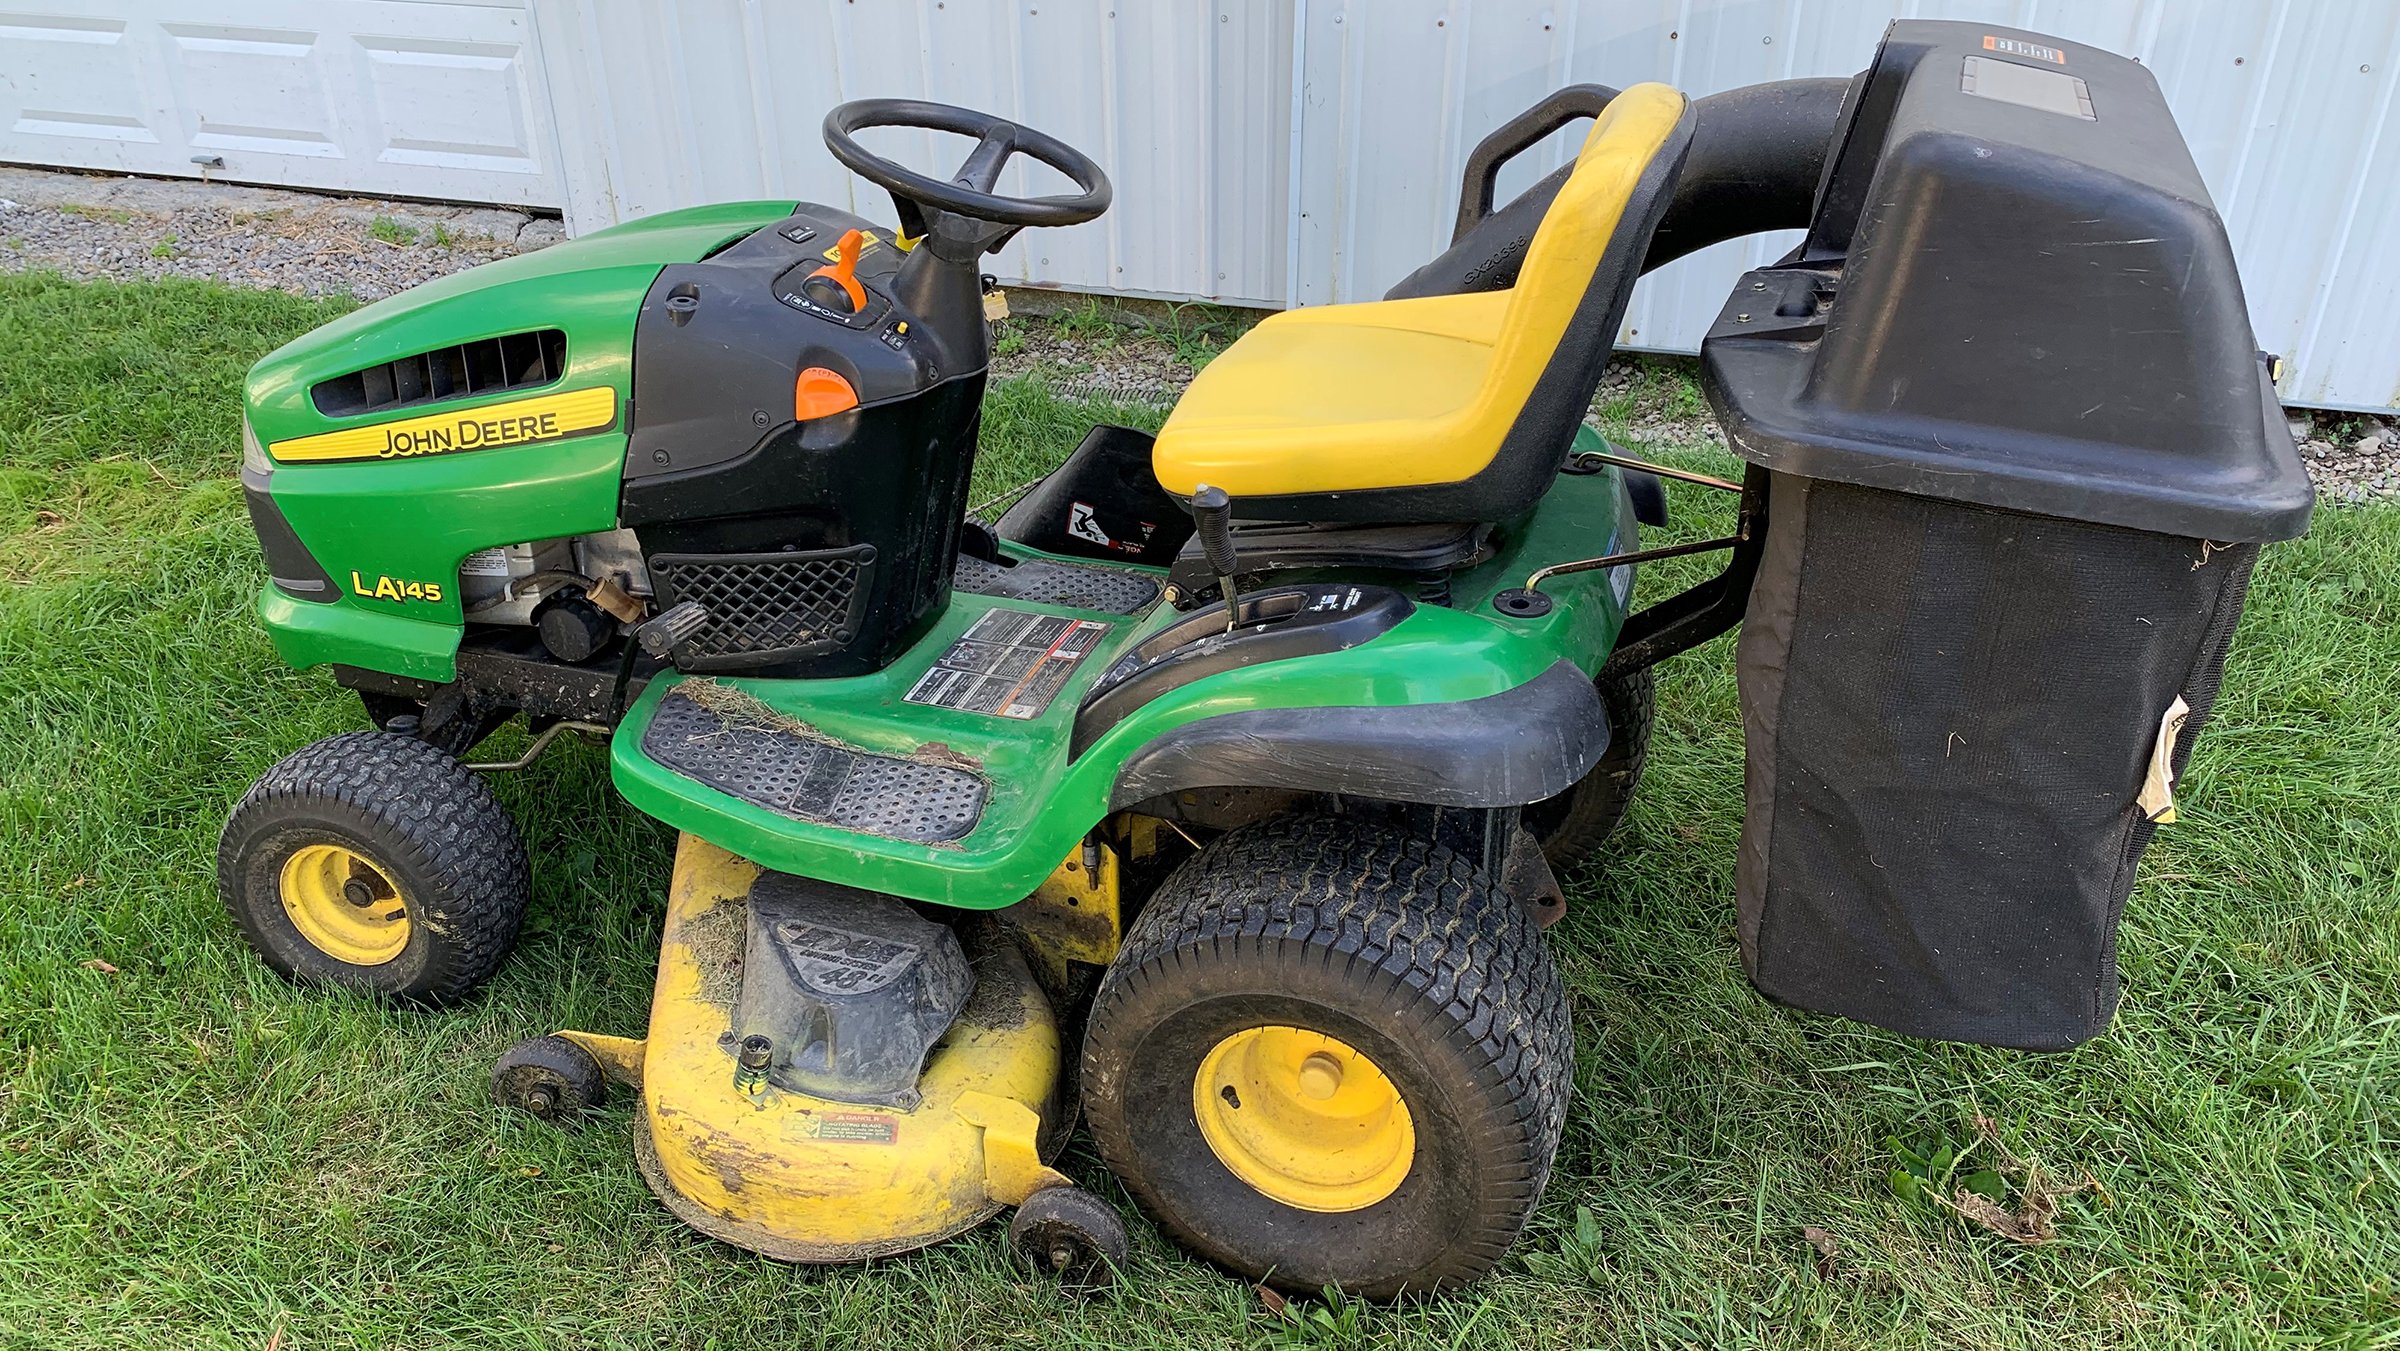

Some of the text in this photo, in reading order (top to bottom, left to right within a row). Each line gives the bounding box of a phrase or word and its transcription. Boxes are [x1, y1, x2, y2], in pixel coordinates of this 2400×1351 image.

[380, 412, 559, 455] JOHN DEERE
[352, 571, 442, 601] LA145
